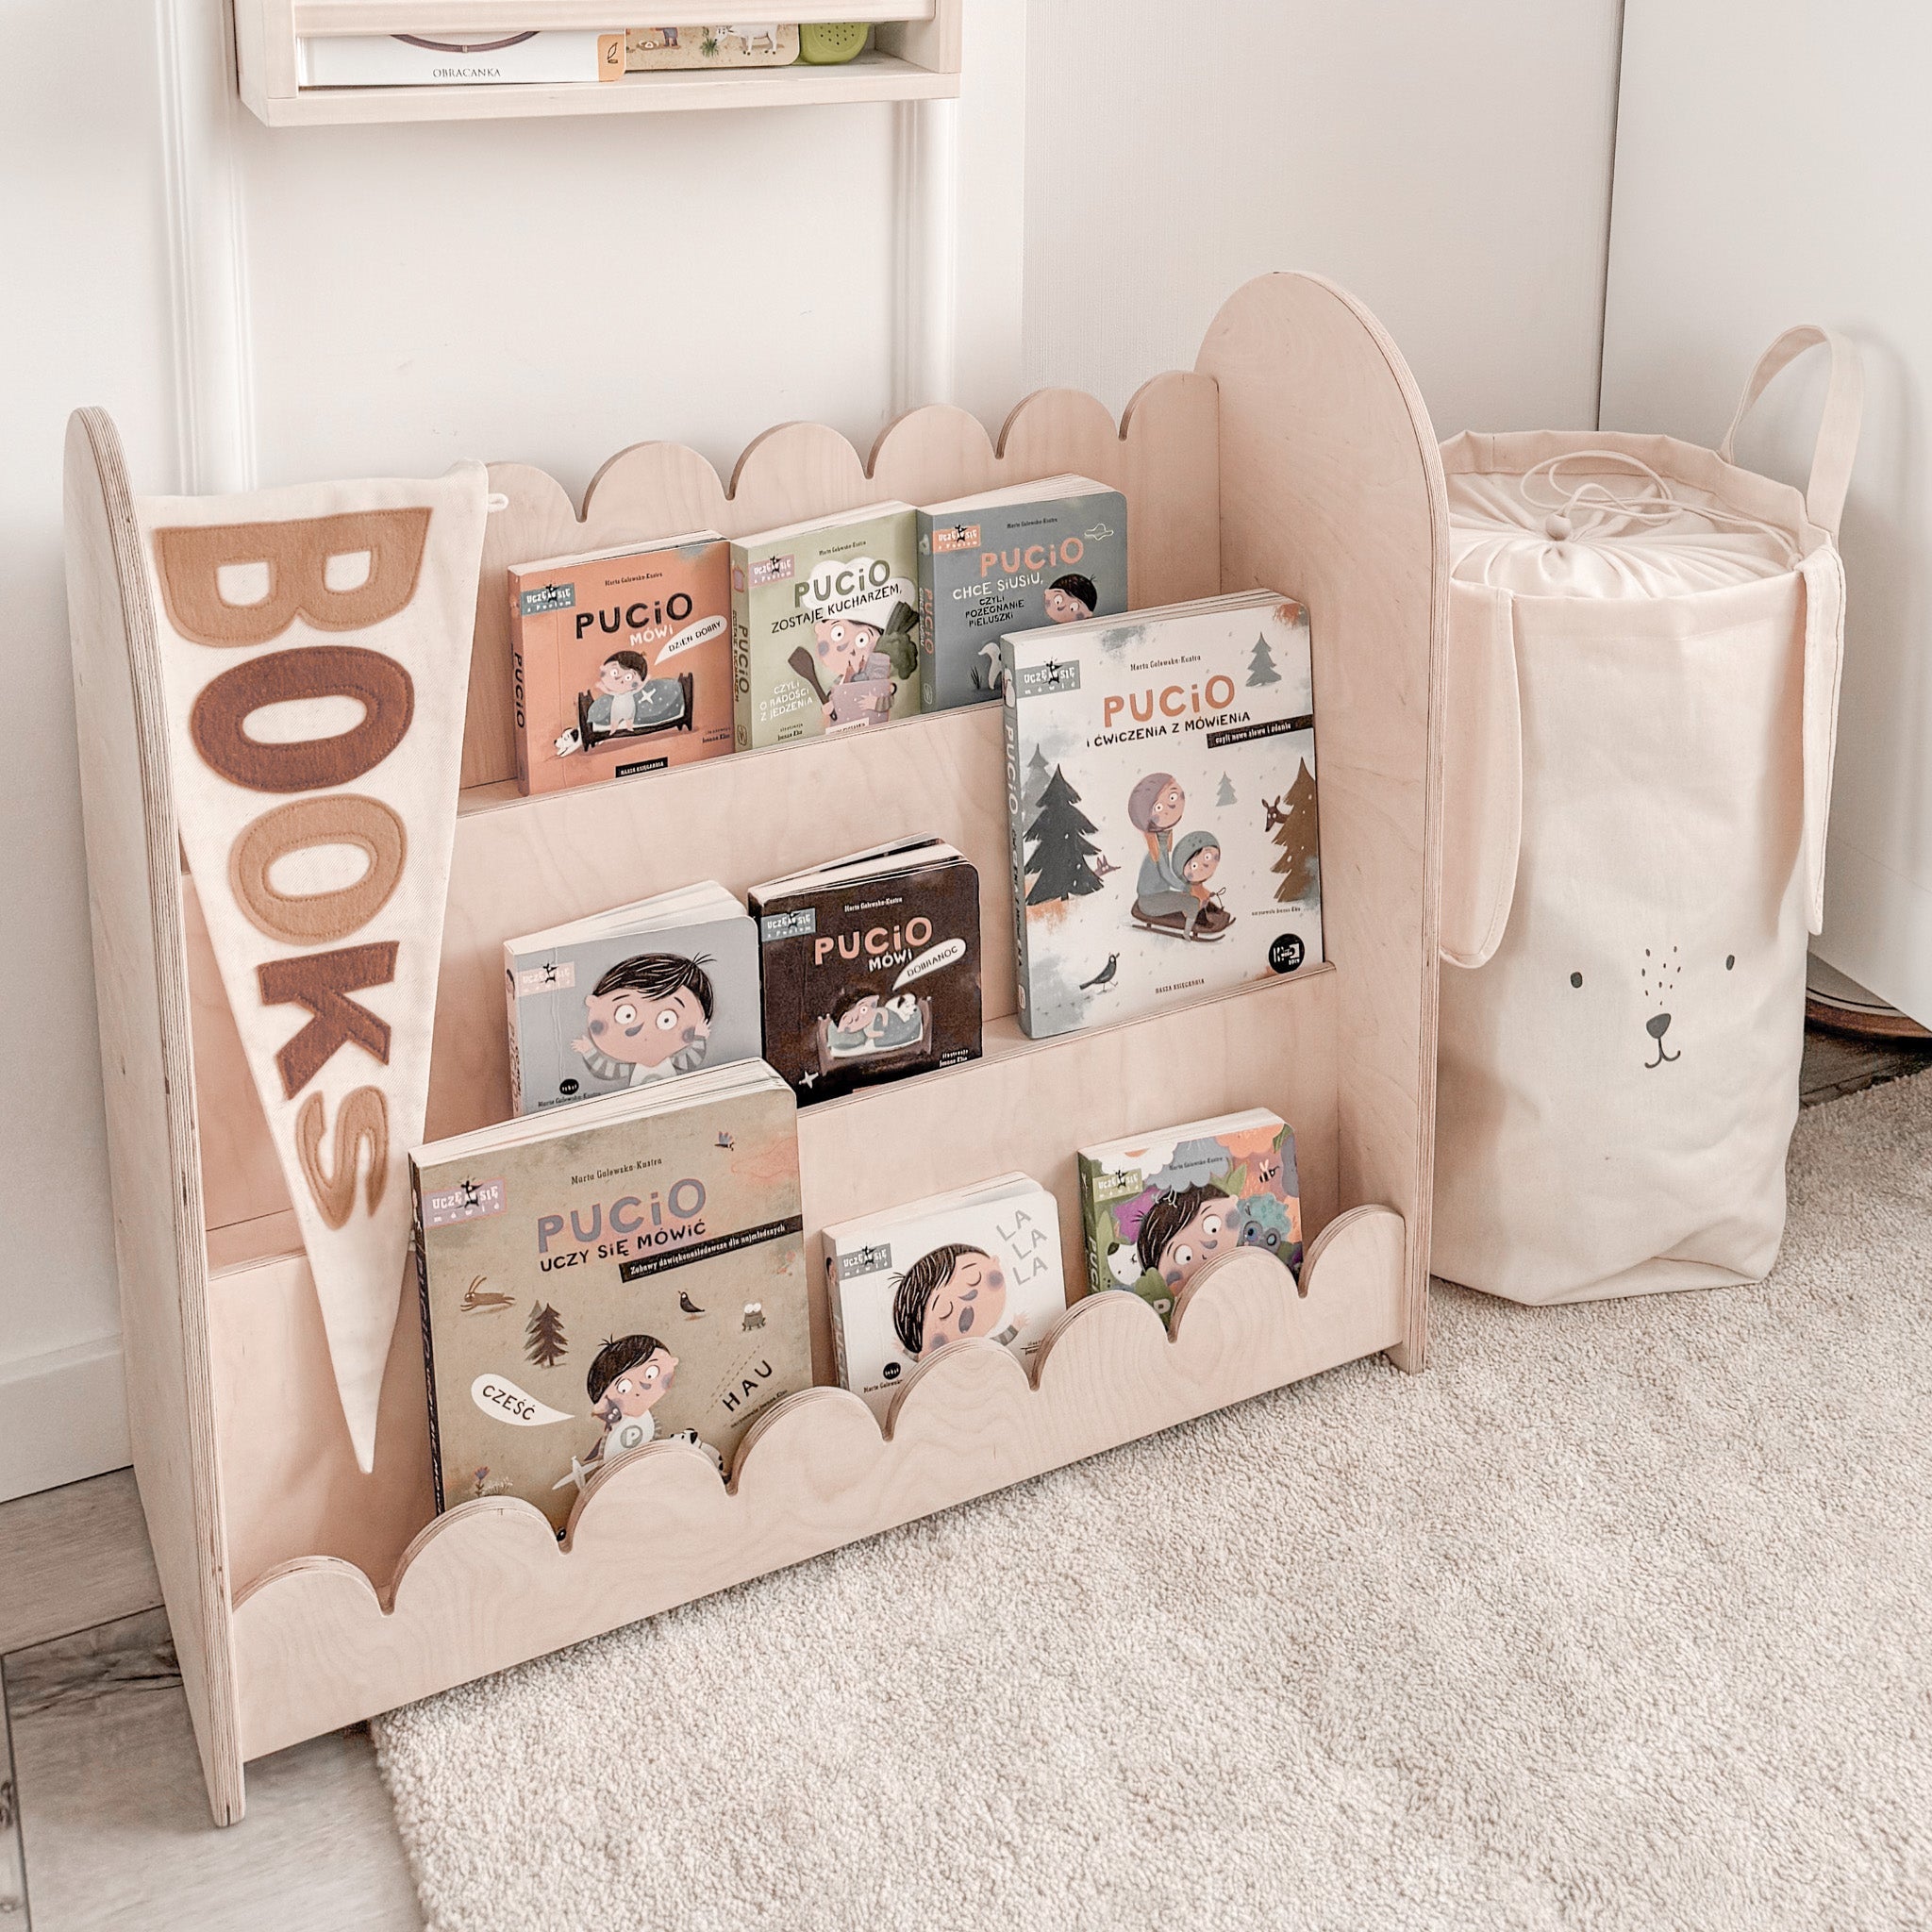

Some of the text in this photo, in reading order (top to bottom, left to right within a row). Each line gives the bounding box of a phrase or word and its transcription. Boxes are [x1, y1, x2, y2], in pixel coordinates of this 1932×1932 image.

[432, 68, 501, 77] OBRACANKA
[980, 537, 1084, 578] PUCiO
[794, 559, 891, 608] PUCiO
[953, 582, 992, 600] CHCE
[575, 592, 693, 640] PUCiO
[771, 583, 903, 634] ZOSTAJE KUCHARZEM,
[760, 712, 767, 722] Z
[1103, 675, 1236, 728] PUCiO
[1171, 723, 1179, 734] Z
[153, 506, 434, 1230] BOOKS
[814, 917, 933, 965] PUCiO
[432, 1185, 499, 1209] UCZĘ SIĘ
[571, 1174, 594, 1186] Marta
[538, 1178, 707, 1254] PUCiO
[996, 1209, 1032, 1241] LA
[540, 1249, 590, 1272] UCZY
[1011, 1228, 1048, 1259] LA
[1012, 1257, 1049, 1286] LA
[722, 1359, 773, 1412] HAU
[482, 1385, 536, 1421] CZEŚĆ
